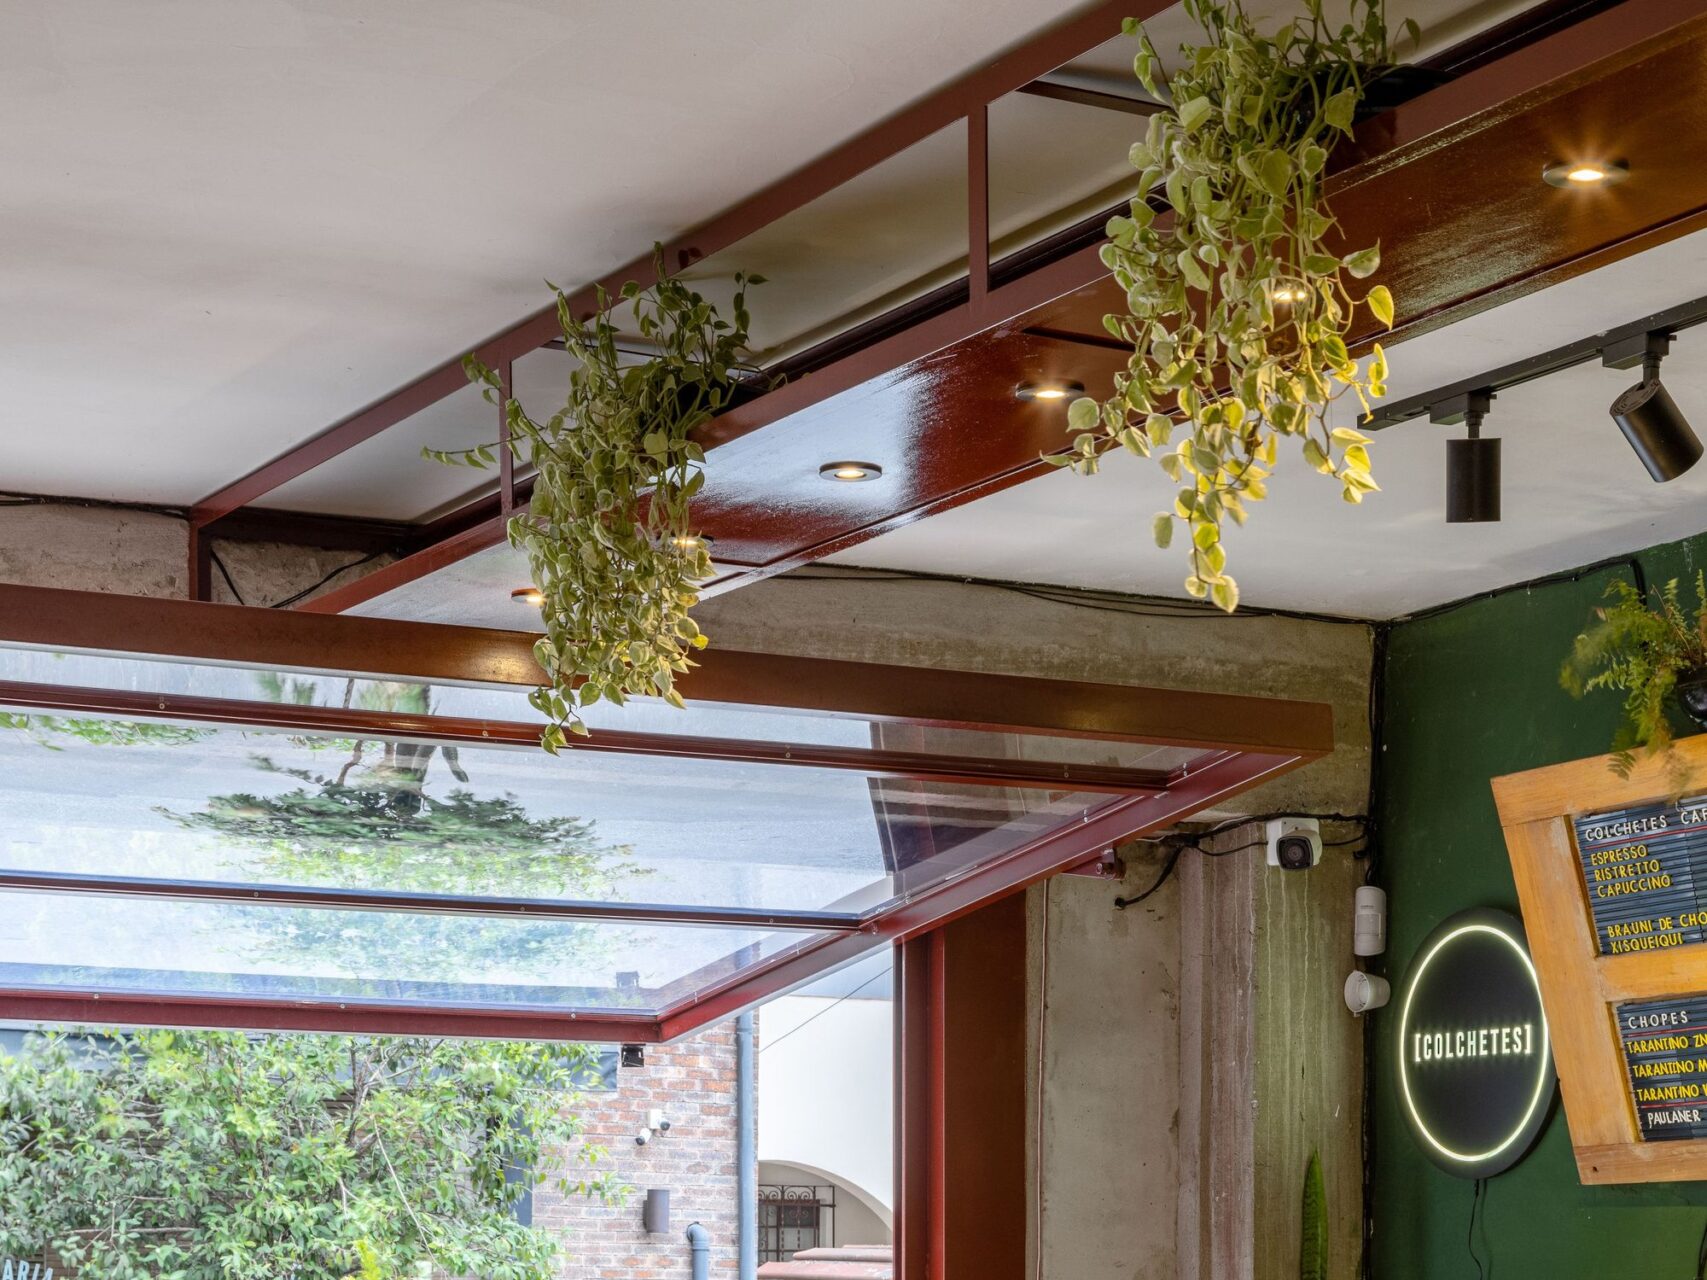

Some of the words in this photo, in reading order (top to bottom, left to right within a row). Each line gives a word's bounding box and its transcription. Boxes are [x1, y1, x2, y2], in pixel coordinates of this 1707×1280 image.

[1585, 814, 1668, 842] COLCHETES
[1590, 844, 1648, 866] ESPRESSO
[1594, 859, 1660, 882] RISTRETTO
[1597, 874, 1671, 898] CAPUCCINO
[1607, 919, 1653, 938] BRAUNI
[1659, 916, 1673, 931] DE
[1679, 911, 1707, 927] CHO
[1610, 932, 1684, 954] XISQUEIQUI
[1628, 1010, 1689, 1029] CHOPES
[1626, 1036, 1689, 1054] TARANTINO
[1632, 1059, 1695, 1078] TARANTINO
[1637, 1083, 1700, 1102] TARANTINO
[1647, 1109, 1701, 1129] PAULANER
